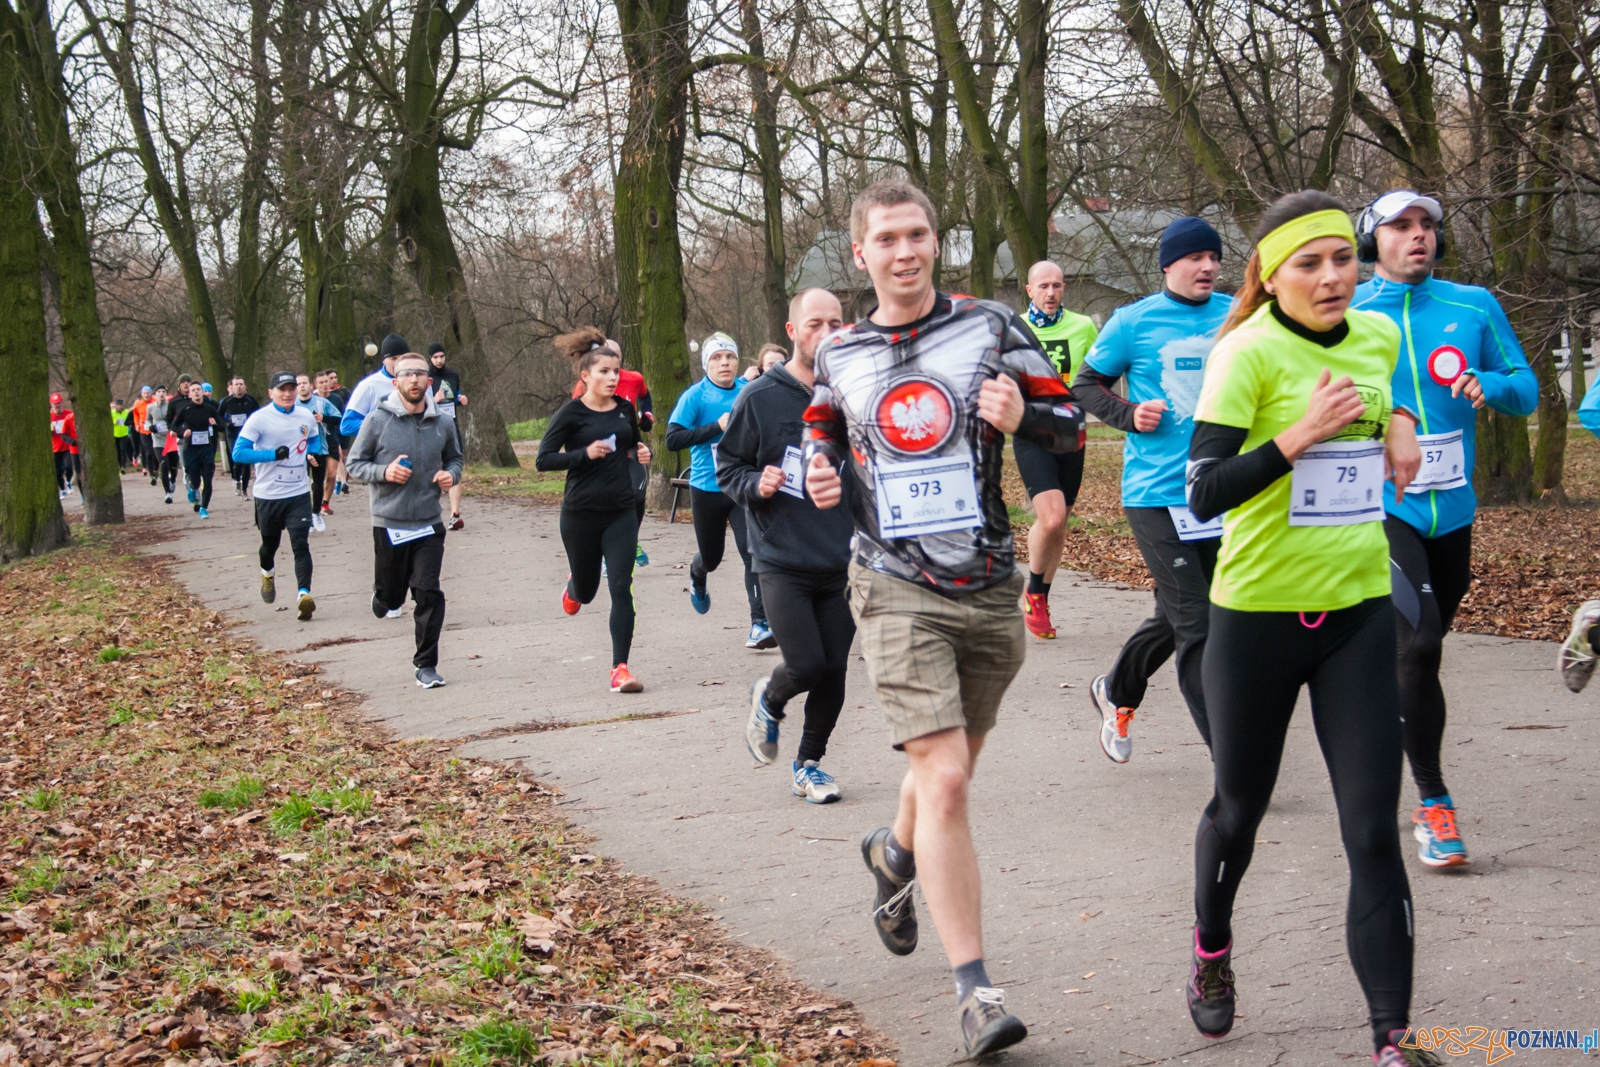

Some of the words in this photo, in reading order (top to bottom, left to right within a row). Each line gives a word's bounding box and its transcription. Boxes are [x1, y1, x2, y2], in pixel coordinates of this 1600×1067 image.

[1426, 450, 1443, 464] 57
[1337, 466, 1357, 483] 79
[909, 480, 942, 498] 973
